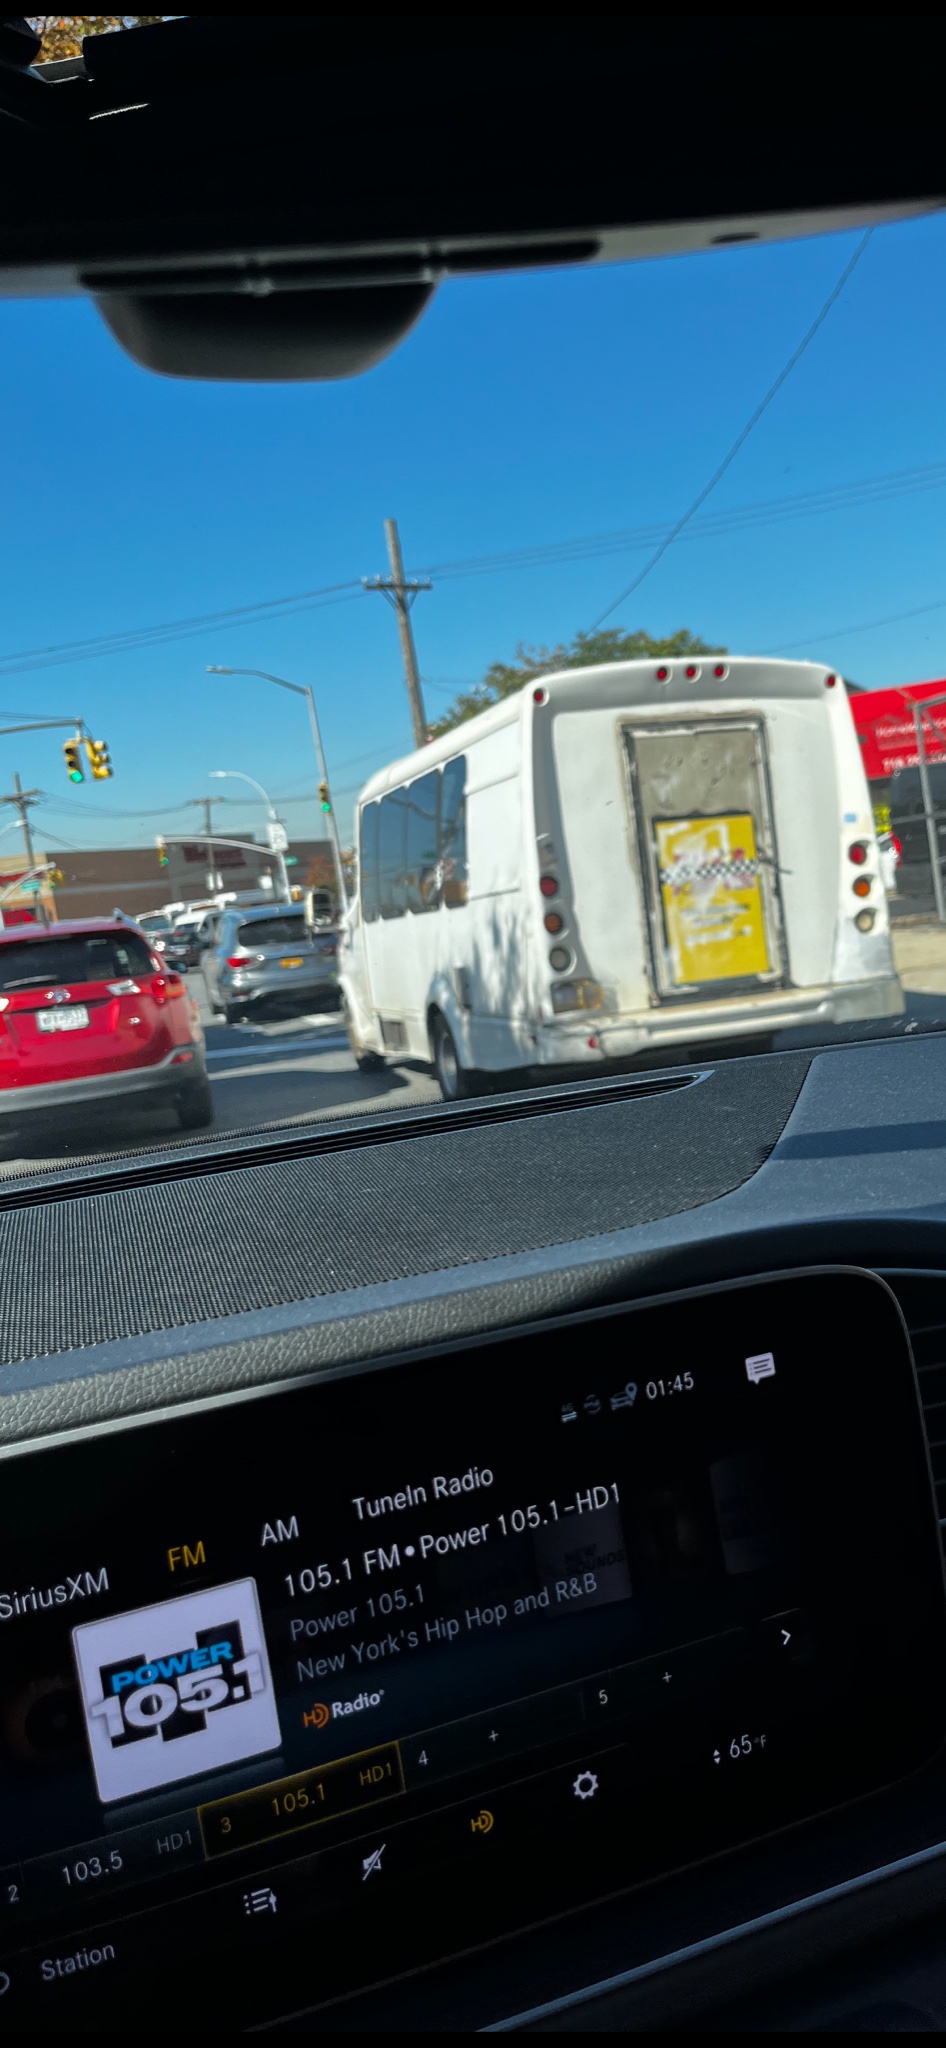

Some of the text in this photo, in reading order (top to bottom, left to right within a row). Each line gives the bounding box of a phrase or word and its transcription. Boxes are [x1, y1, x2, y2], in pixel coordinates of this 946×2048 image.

[645, 1372, 694, 1400] 01:45
[353, 1466, 494, 1520] TuneIn Radio
[167, 1541, 206, 1571] FM
[261, 1516, 299, 1546] AM
[0, 1567, 109, 1619] SiriusXM
[284, 1558, 353, 1597] 105.1
[291, 1584, 425, 1642] Power 105.1
[296, 1572, 598, 1682] New York's Hip Hop and R&B
[111, 1640, 235, 1693] POWER
[90, 1652, 266, 1740] 105.1
[598, 1689, 608, 1705] 5
[418, 1750, 429, 1766] 4
[221, 1762, 393, 1833] 3 105.1 HD1
[8, 1829, 193, 1903] 2 103.5 HD1
[41, 1943, 116, 1982] Station
